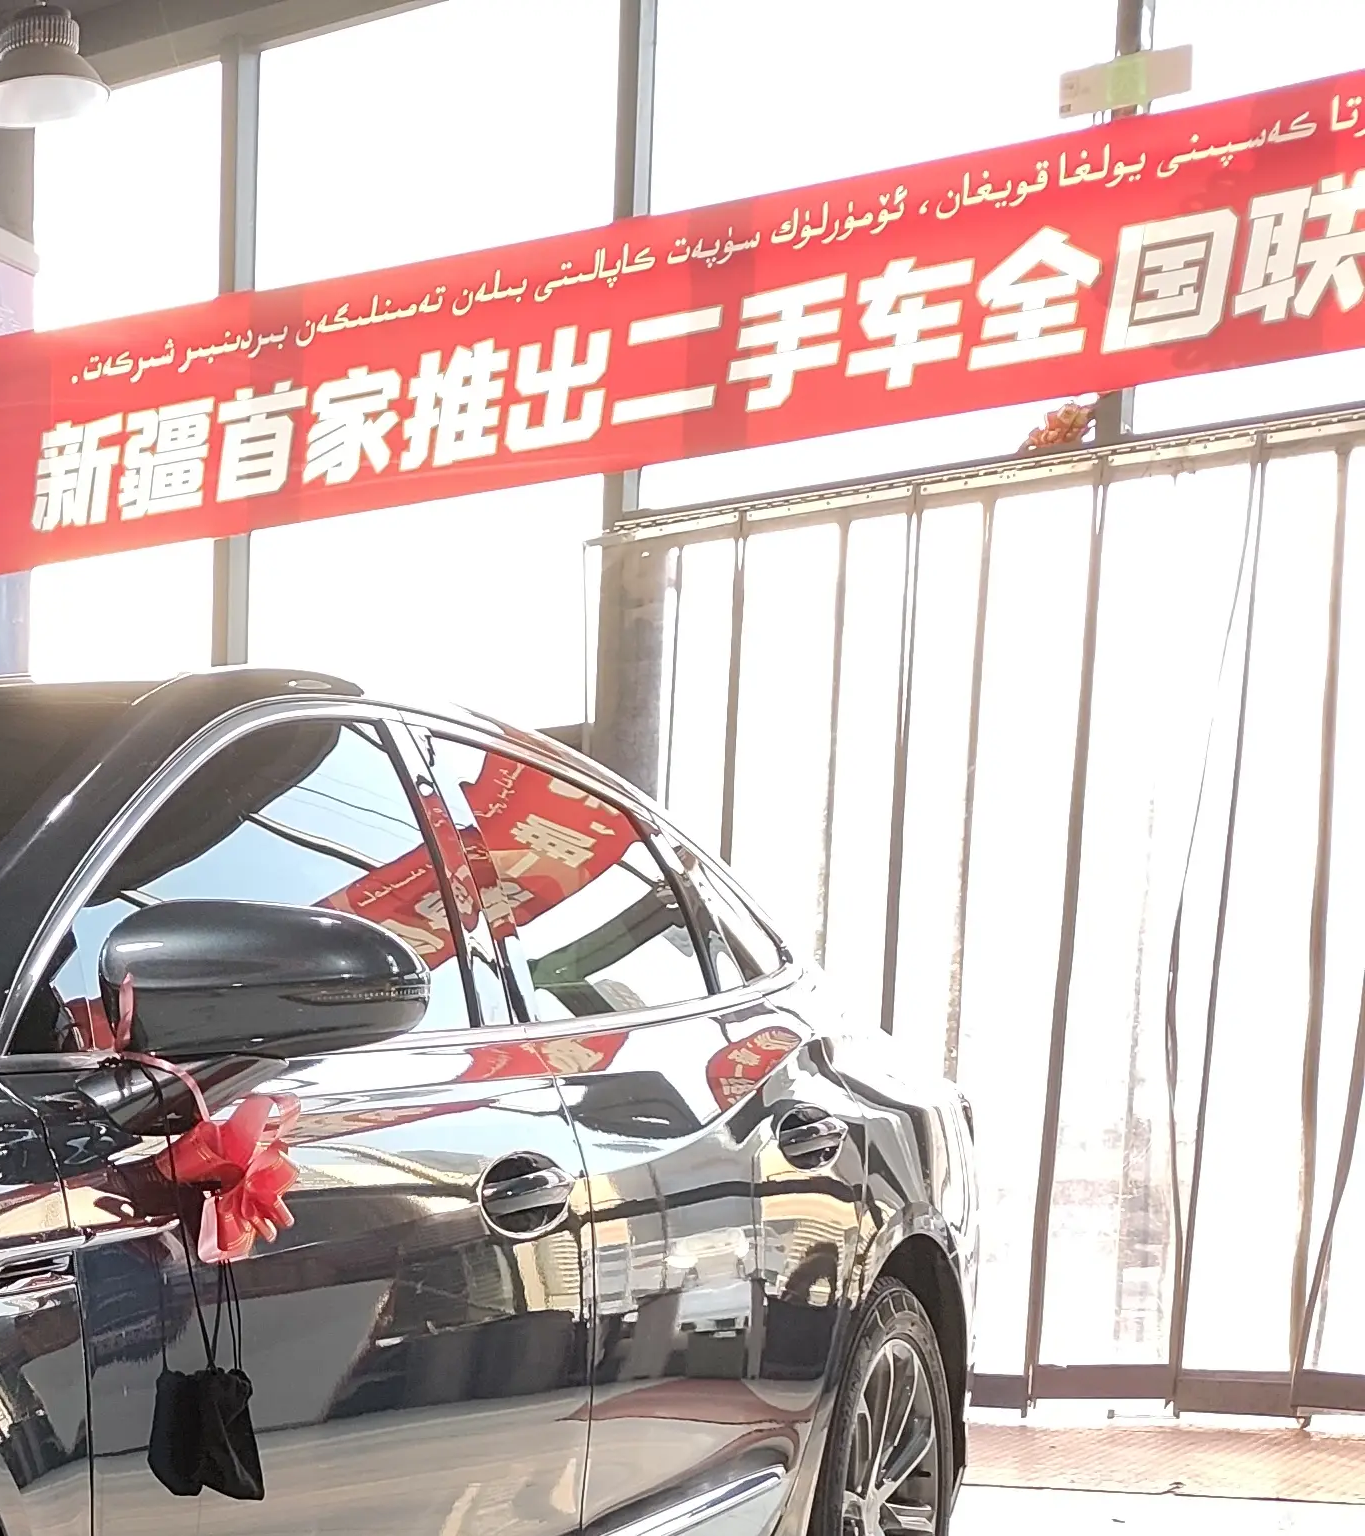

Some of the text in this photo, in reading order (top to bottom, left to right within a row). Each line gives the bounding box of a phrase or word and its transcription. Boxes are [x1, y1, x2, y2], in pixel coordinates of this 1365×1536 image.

[1058, 143, 1146, 188] يولغا
[666, 227, 760, 269] سۈپەت
[451, 269, 528, 316] بىلەن
[31, 172, 1365, 532] 新疆首家推出二手车全国联
